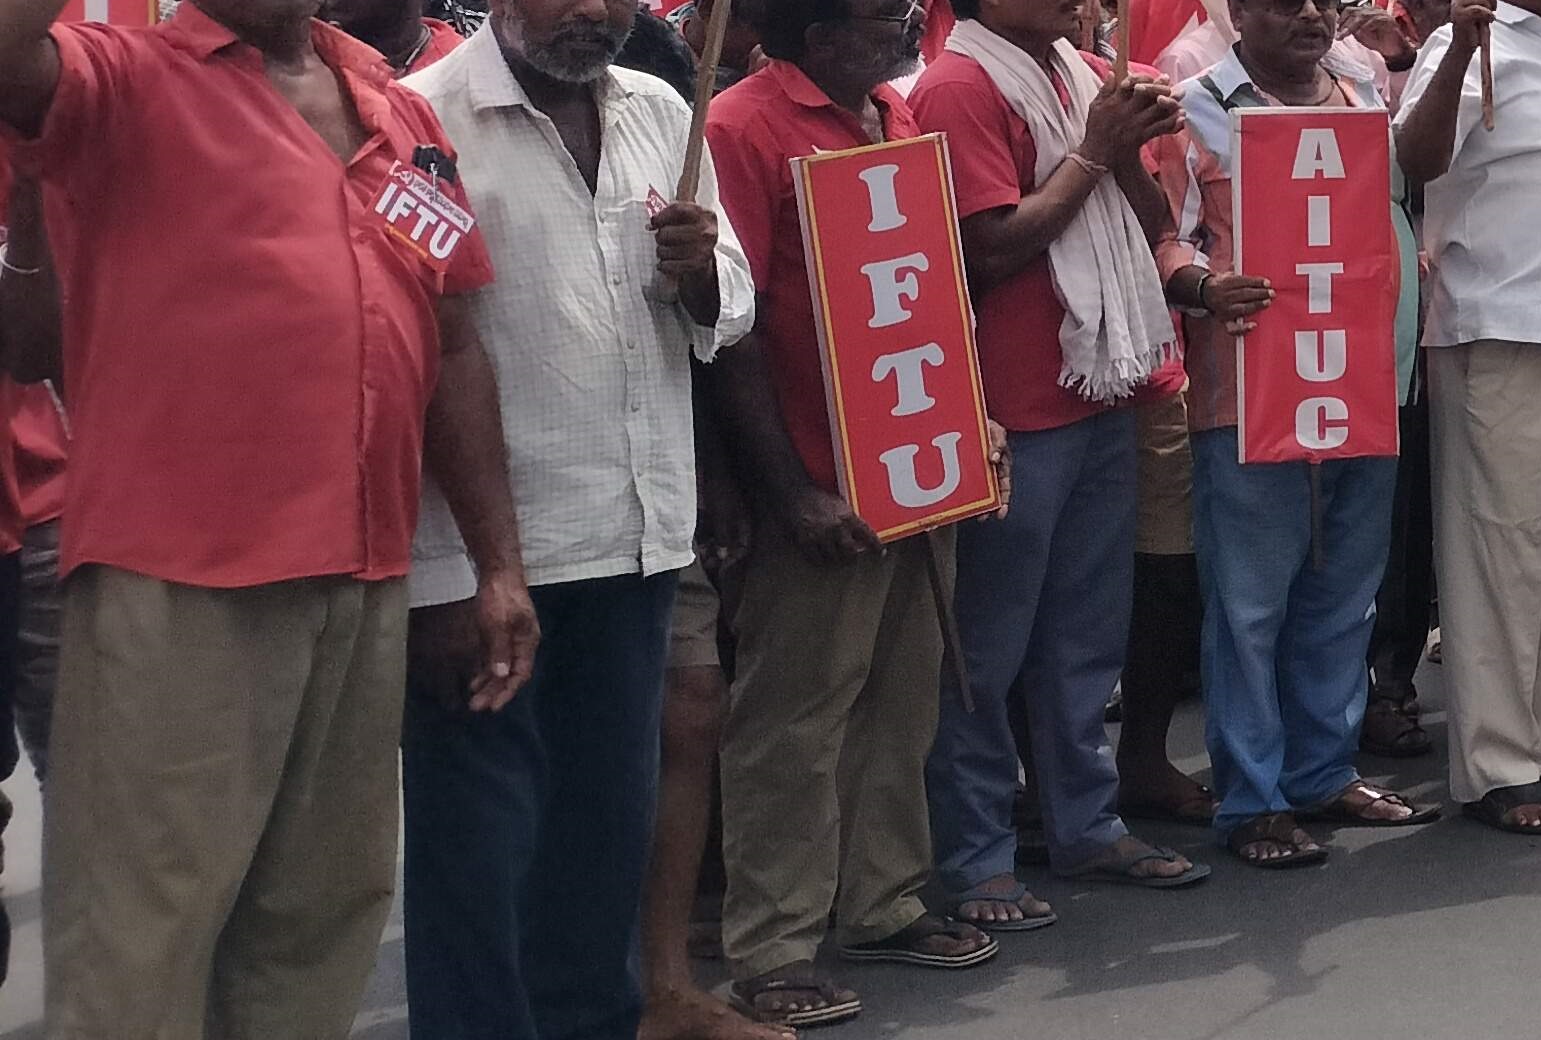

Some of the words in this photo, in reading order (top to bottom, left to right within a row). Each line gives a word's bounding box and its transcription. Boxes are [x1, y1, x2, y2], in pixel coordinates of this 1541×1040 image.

[375, 182, 460, 260] IFTU
[858, 164, 962, 508] IFTU
[1292, 128, 1349, 450] AITUC
